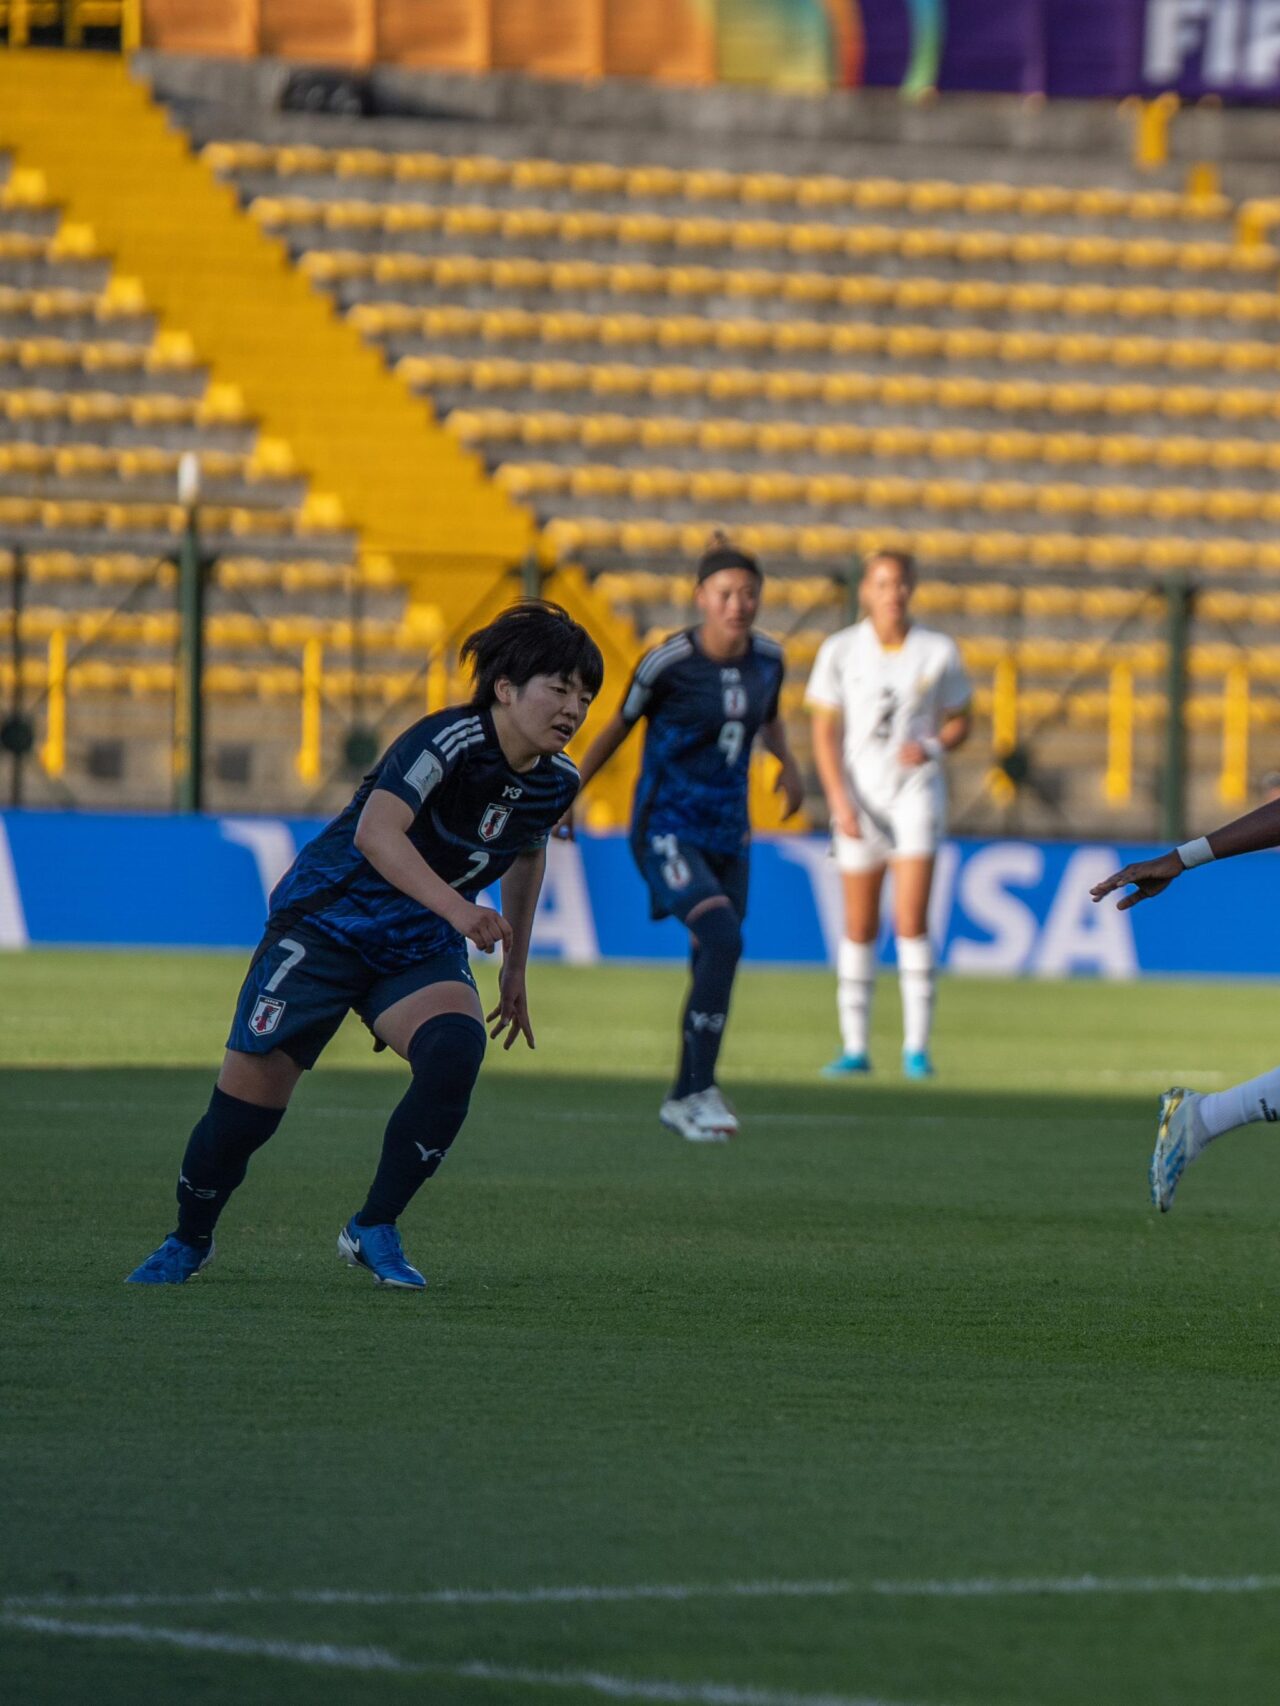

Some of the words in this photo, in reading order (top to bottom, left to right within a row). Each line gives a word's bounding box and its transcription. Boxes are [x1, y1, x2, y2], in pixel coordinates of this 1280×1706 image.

[718, 720, 747, 767] 9
[502, 785, 523, 800] Y-3
[447, 850, 490, 888] 7
[263, 938, 306, 992] 7
